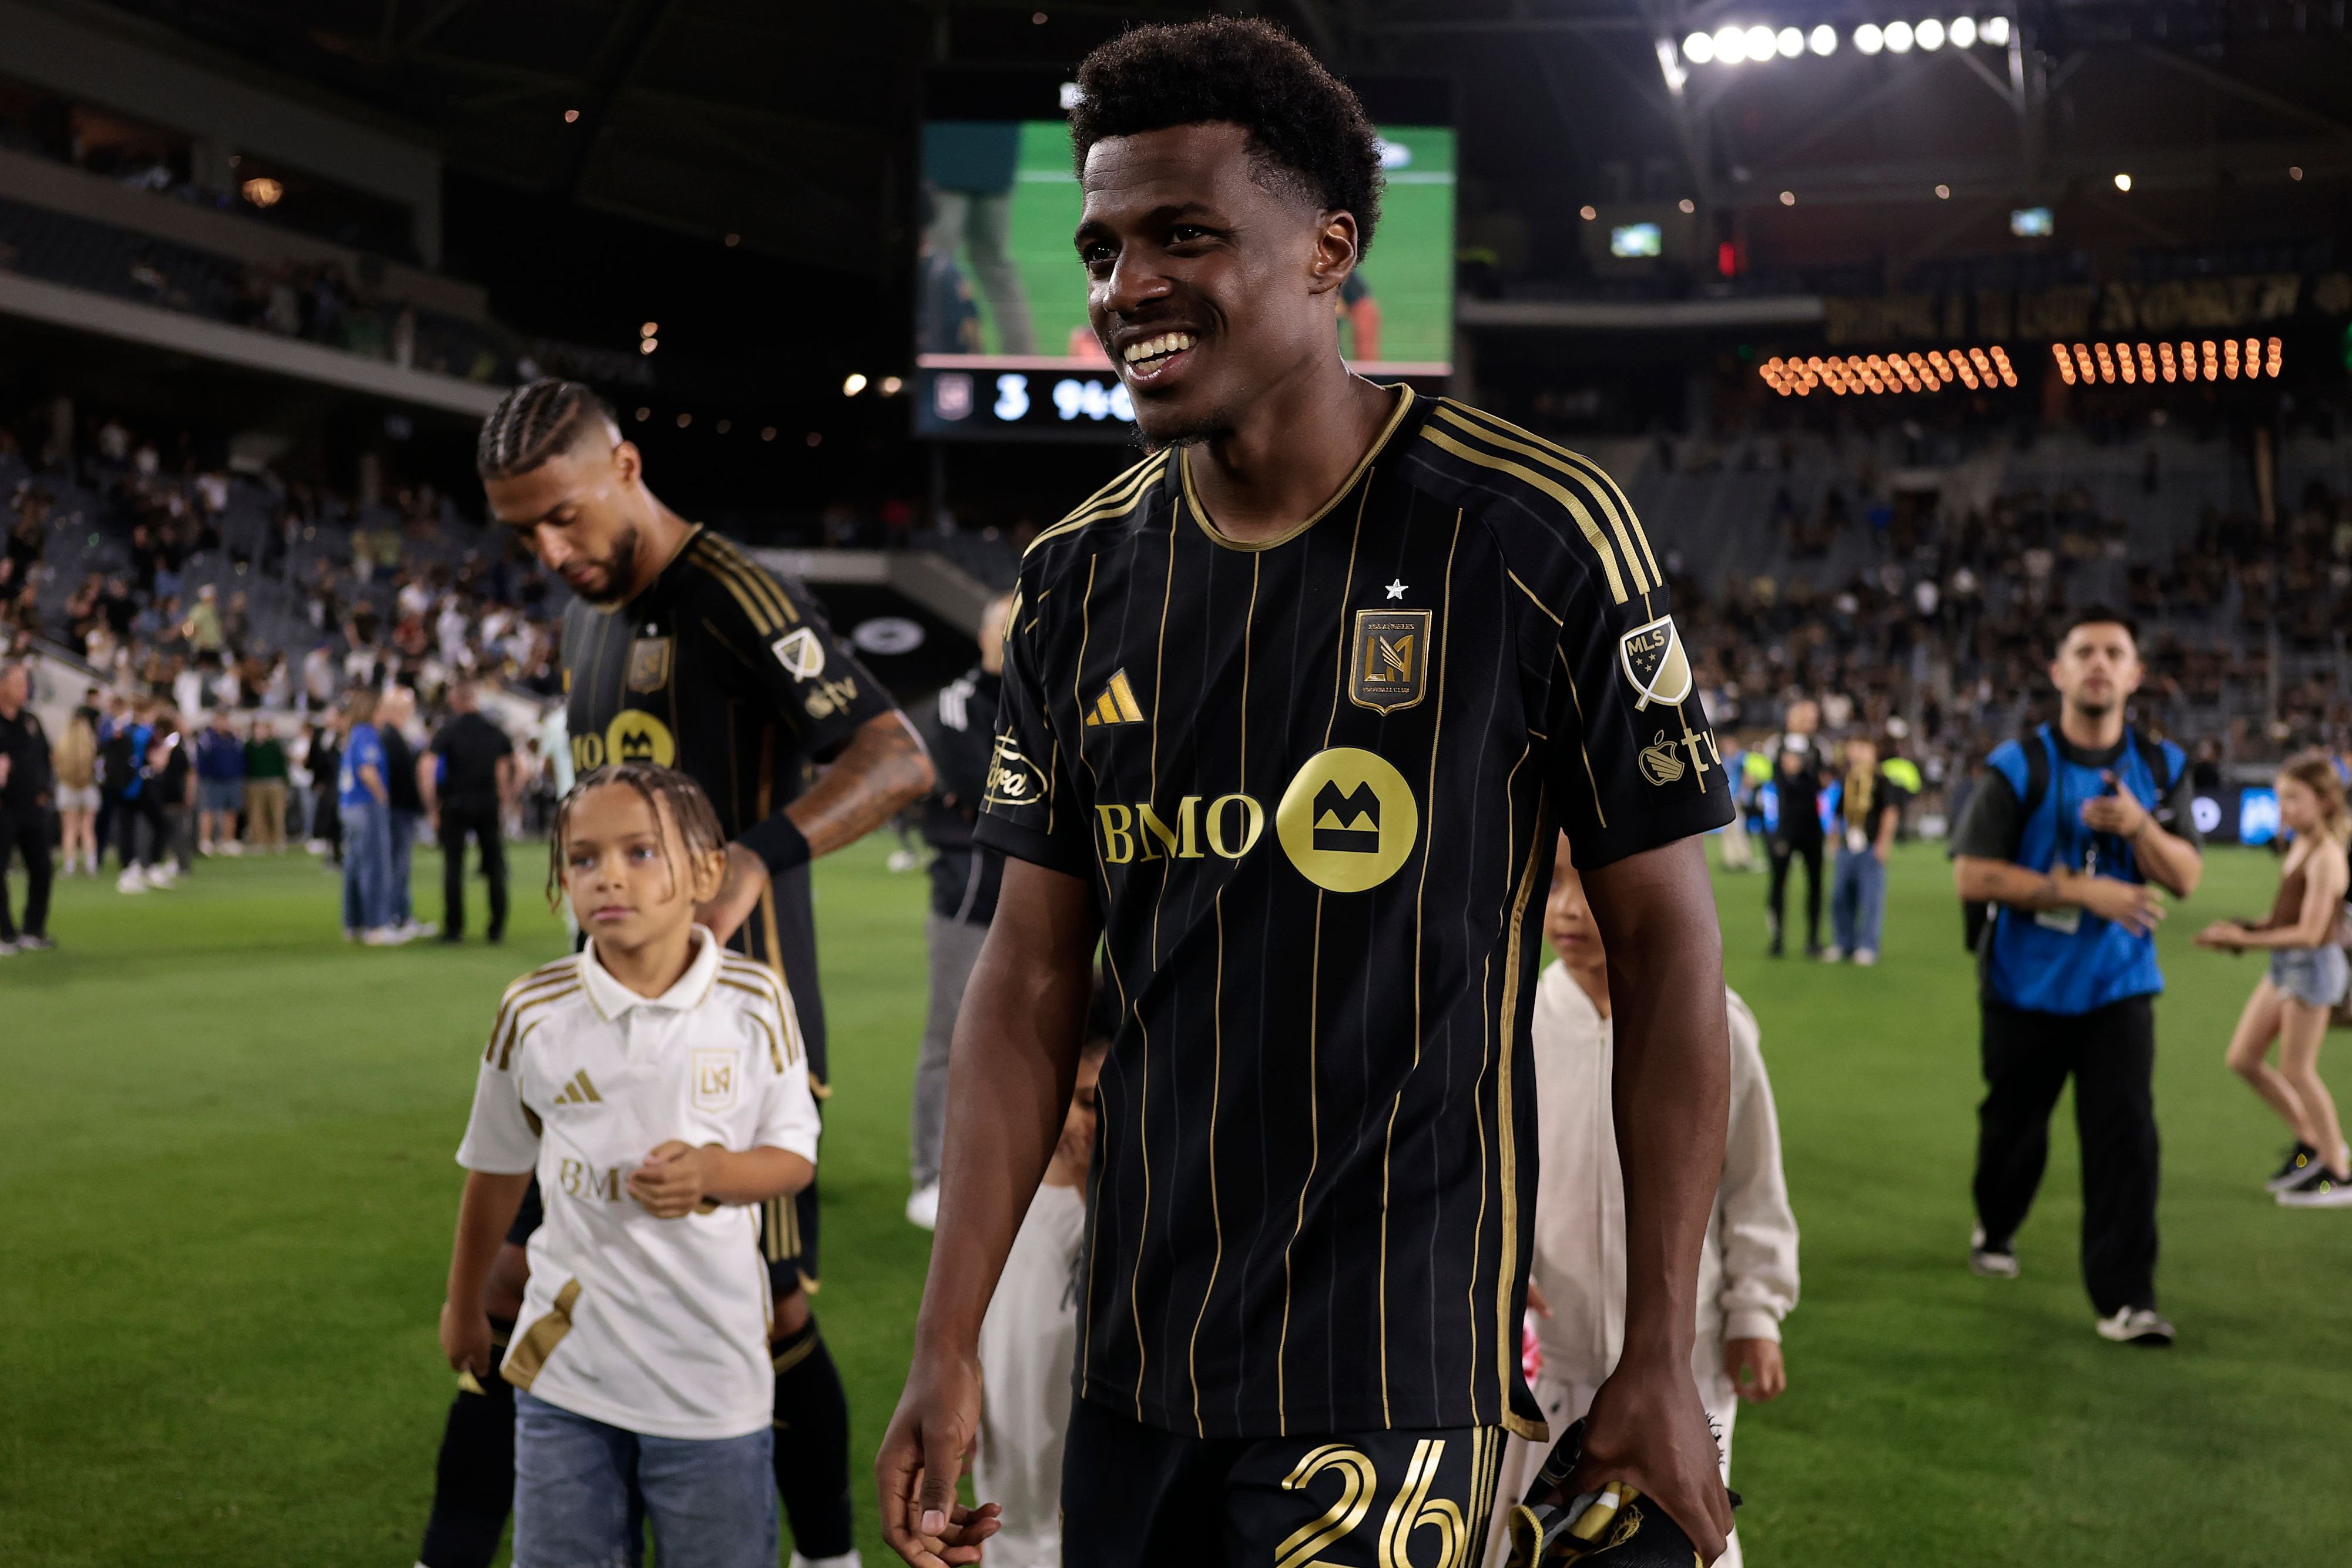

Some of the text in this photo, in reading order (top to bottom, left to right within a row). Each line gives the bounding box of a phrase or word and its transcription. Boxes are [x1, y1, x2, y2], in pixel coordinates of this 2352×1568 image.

[1627, 630, 1665, 656] MLS
[1681, 727, 1722, 772] tv
[1095, 793, 1264, 864] BMO
[560, 1157, 625, 1203] BM
[1275, 1439, 1466, 1568] 26
